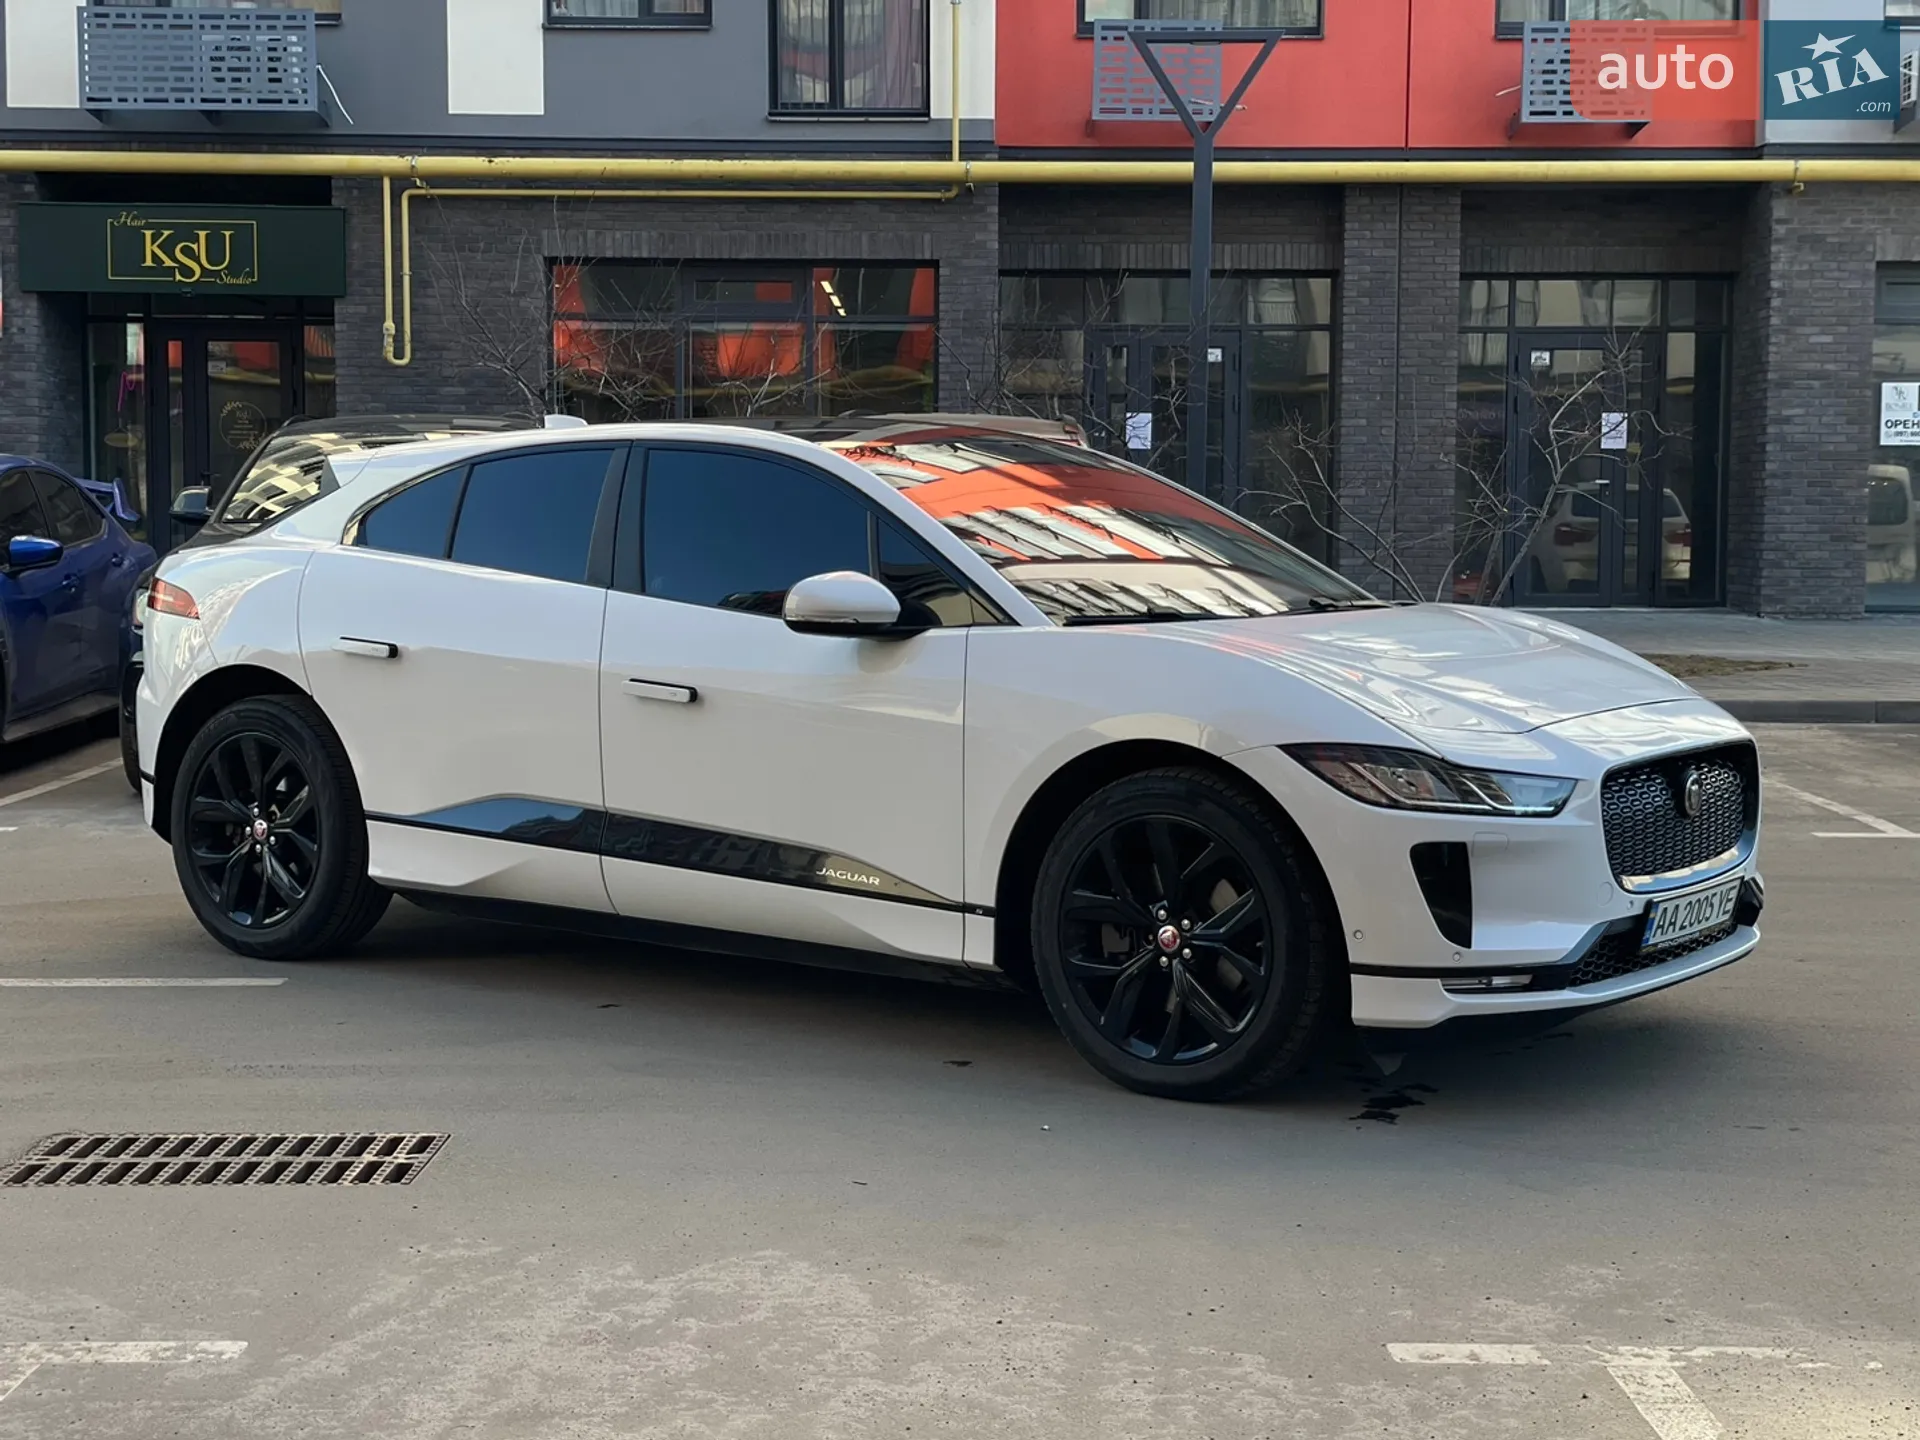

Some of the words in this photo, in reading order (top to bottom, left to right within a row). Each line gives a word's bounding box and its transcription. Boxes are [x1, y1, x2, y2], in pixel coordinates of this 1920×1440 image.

[114, 211, 147, 227] Hair
[140, 229, 235, 283] KSU
[216, 268, 252, 284] Studio
[816, 867, 880, 886] JAGUAR
[1652, 904, 1680, 938] AA
[1678, 892, 1718, 931] 2005
[1716, 885, 1737, 919] YE
